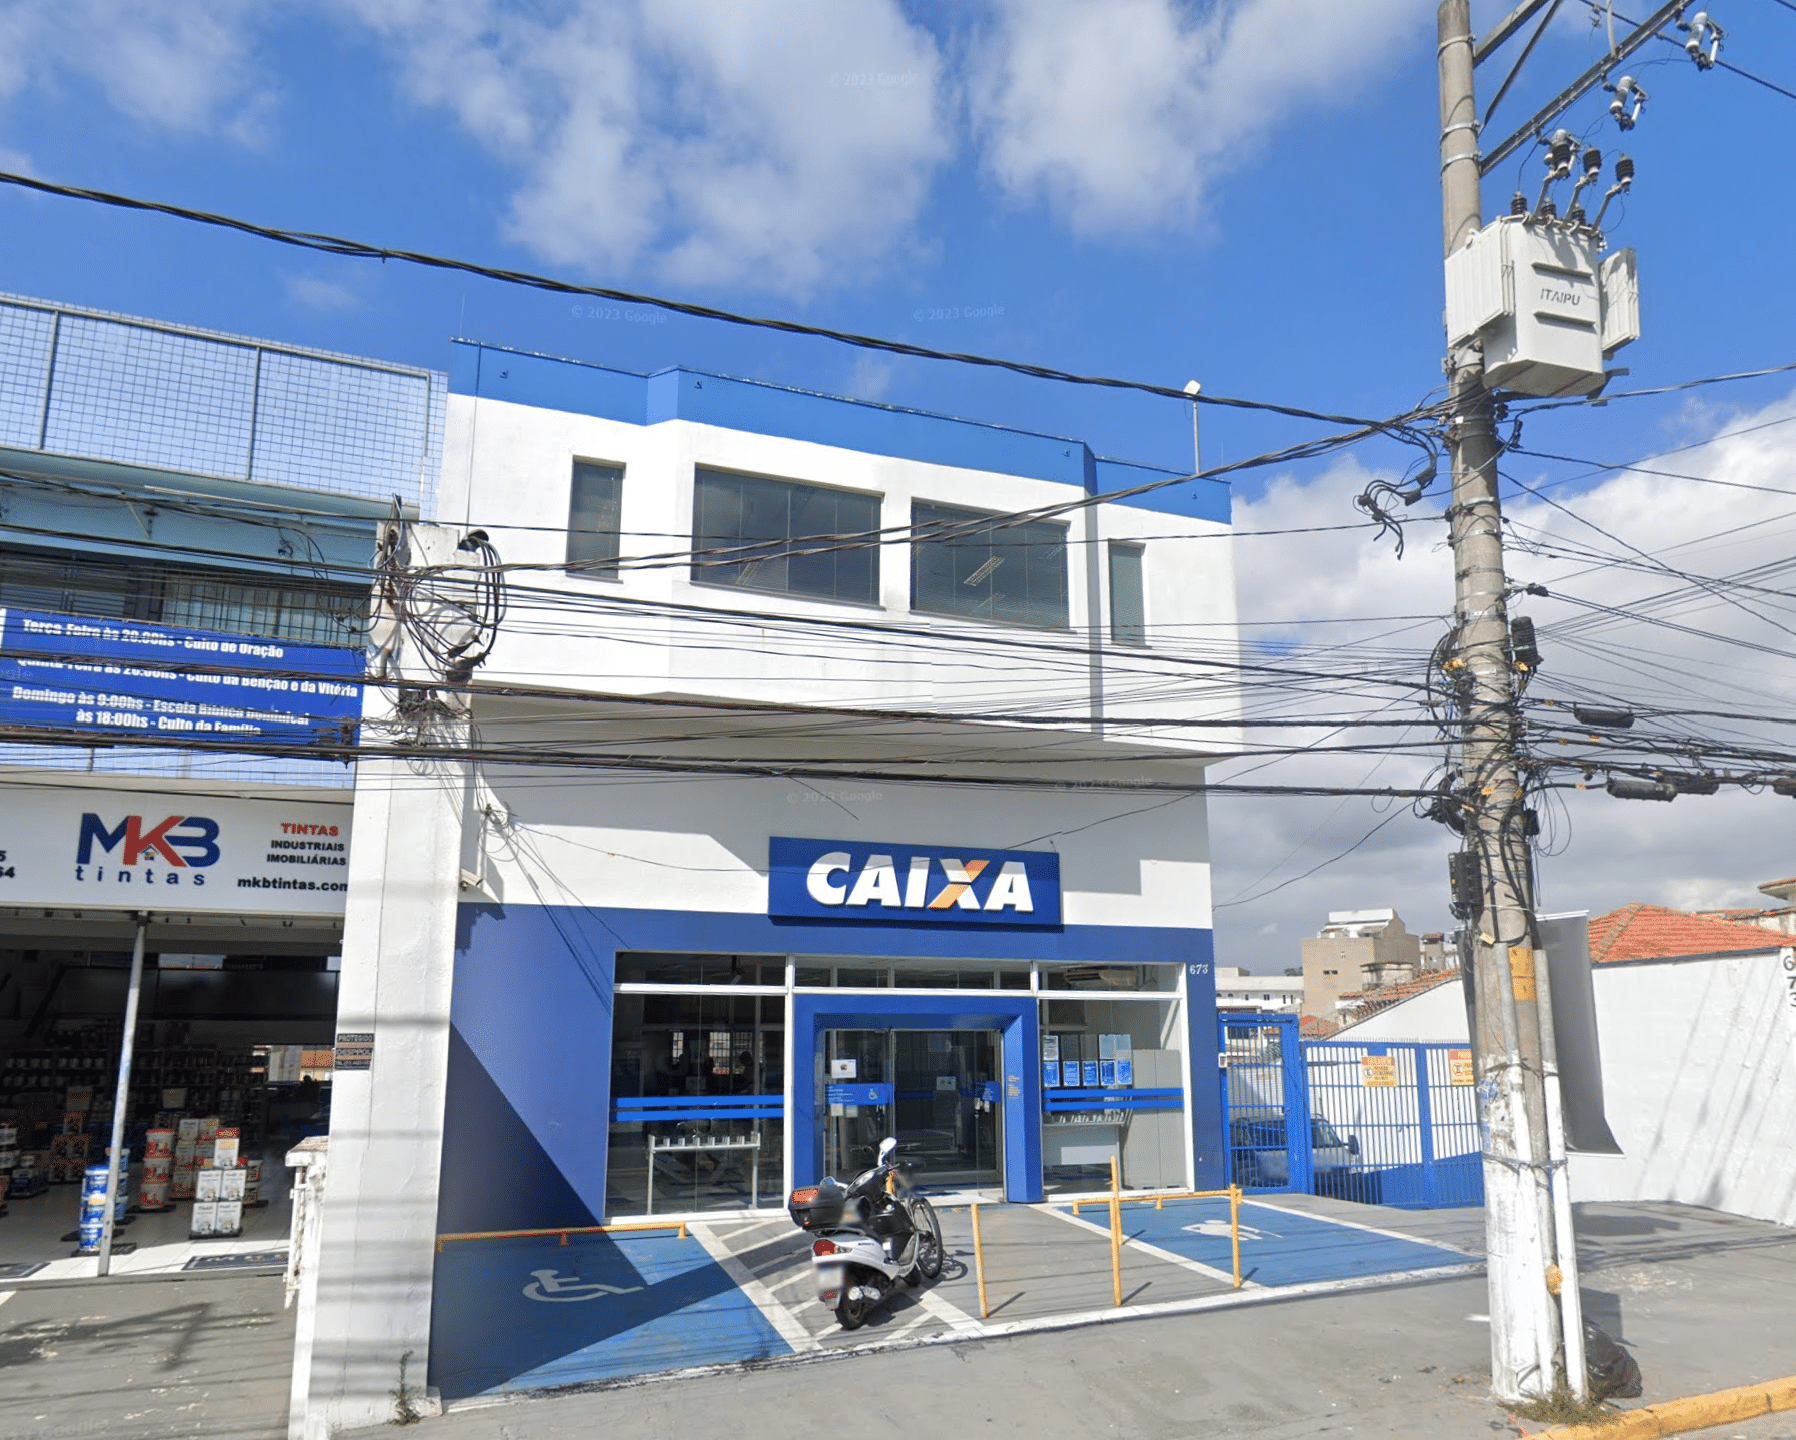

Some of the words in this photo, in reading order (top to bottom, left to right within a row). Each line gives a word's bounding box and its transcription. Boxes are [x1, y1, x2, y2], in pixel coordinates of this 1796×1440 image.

[1540, 288, 1580, 306] ITAIPU
[239, 643, 284, 658] Oração
[12, 686, 76, 704] Domingo
[77, 691, 95, 705] às
[290, 680, 299, 691] e
[300, 680, 316, 693] da
[318, 681, 358, 697] Vitória
[76, 708, 93, 723] às
[95, 711, 148, 728] 18:00hs
[158, 716, 194, 731] Culto
[195, 719, 213, 732] da
[280, 822, 339, 837] TINTAS
[76, 812, 221, 868] MKB
[271, 839, 345, 852] INDUSTRIAIS
[266, 853, 347, 866] IMOBILIÁRIAS
[75, 866, 205, 886] tintas
[806, 852, 1034, 912] CAIXA
[1189, 964, 1208, 975] 673
